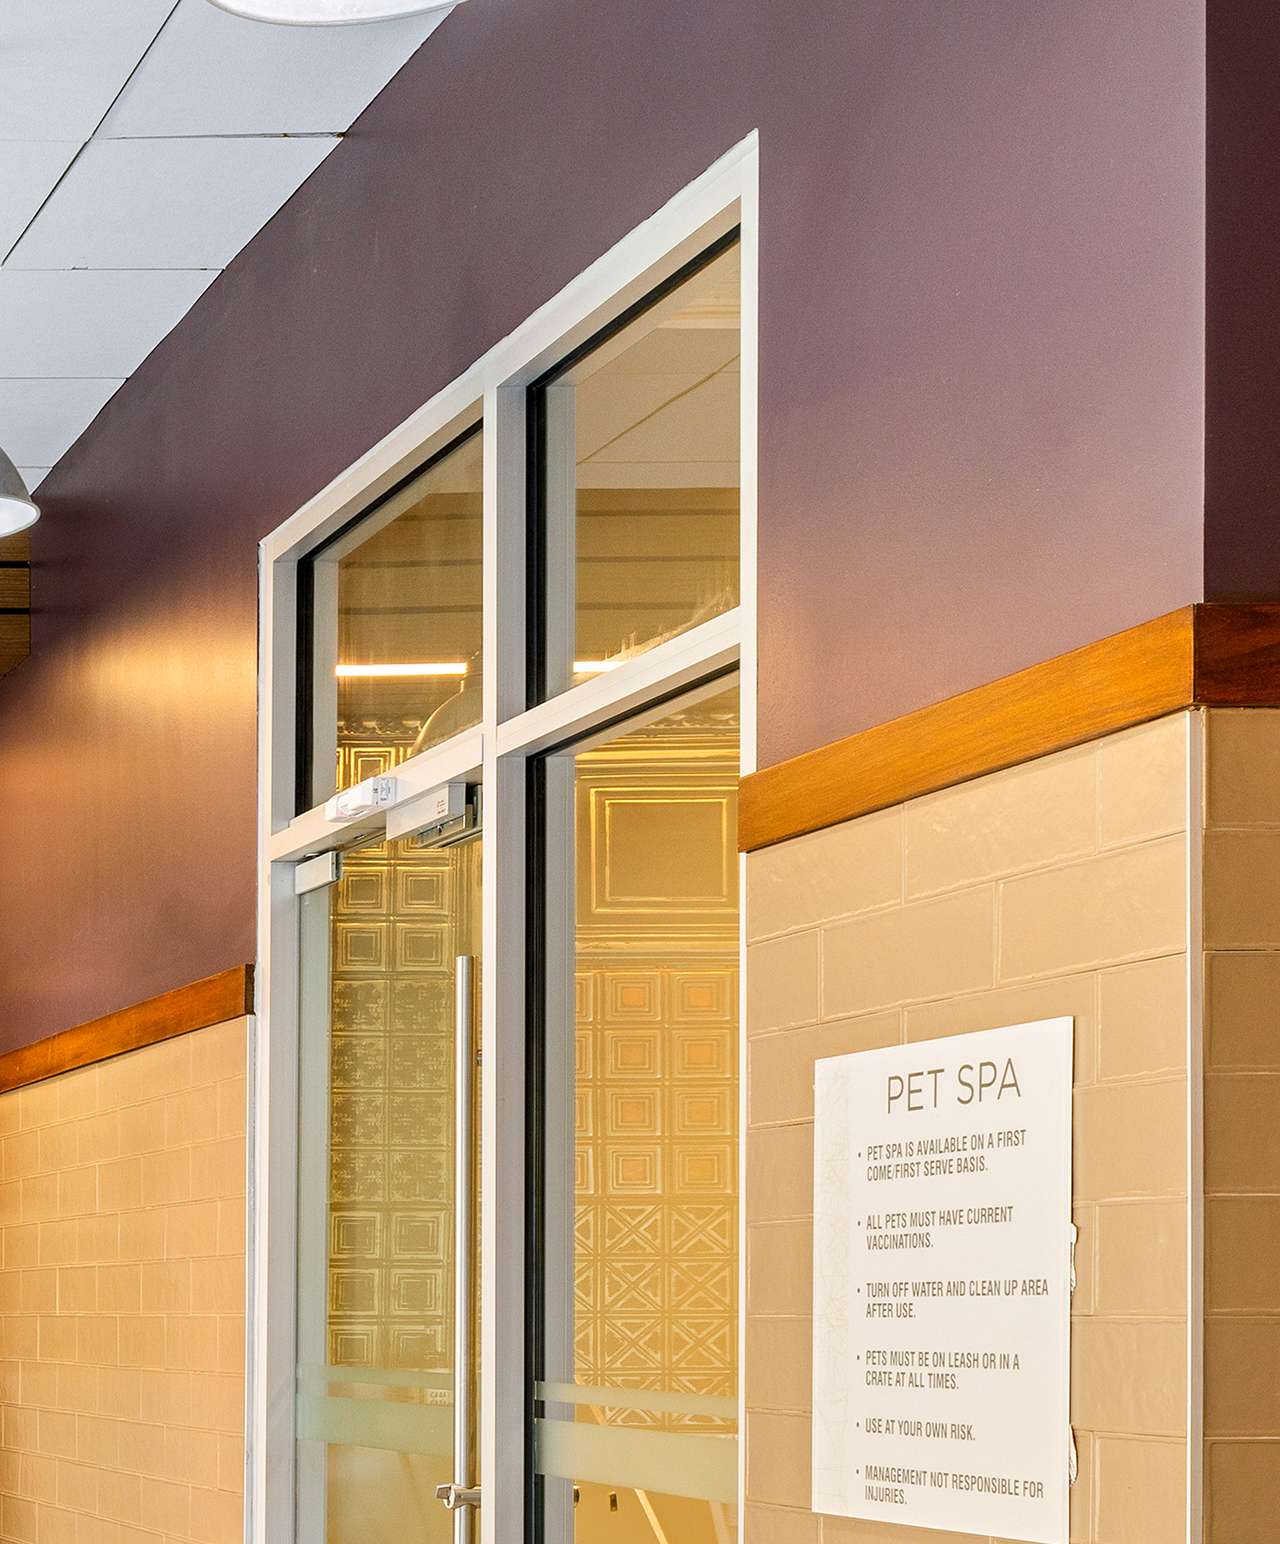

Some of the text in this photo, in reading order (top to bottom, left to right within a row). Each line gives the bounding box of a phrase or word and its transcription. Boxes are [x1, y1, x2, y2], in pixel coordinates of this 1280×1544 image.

[887, 1058, 1021, 1114] PET SPA
[867, 1130, 1026, 1161] PET SPA IS AVAILABLE ON A FIRST
[924, 1159, 953, 1176] SERVE
[957, 1156, 988, 1173] BASIS.
[866, 1206, 1013, 1230] ALL PETS MUST HAVE CURRENT
[866, 1232, 933, 1250] VACCINATIONS.
[866, 1279, 1048, 1298] TURN OFF WATER AND CLEAN UP AREA
[866, 1302, 916, 1318] AFTER USE.
[866, 1350, 1019, 1370] PETS MUST BE ON LEASH OR IN A
[866, 1371, 958, 1389] CRATE AT ALL TIMES.
[866, 1418, 975, 1440] USE AT YOUR OWN RISK.
[865, 1465, 1044, 1498] MANAGEMENT NOT RESPONSIBLE FOR
[865, 1486, 907, 1504] INJURIES.
